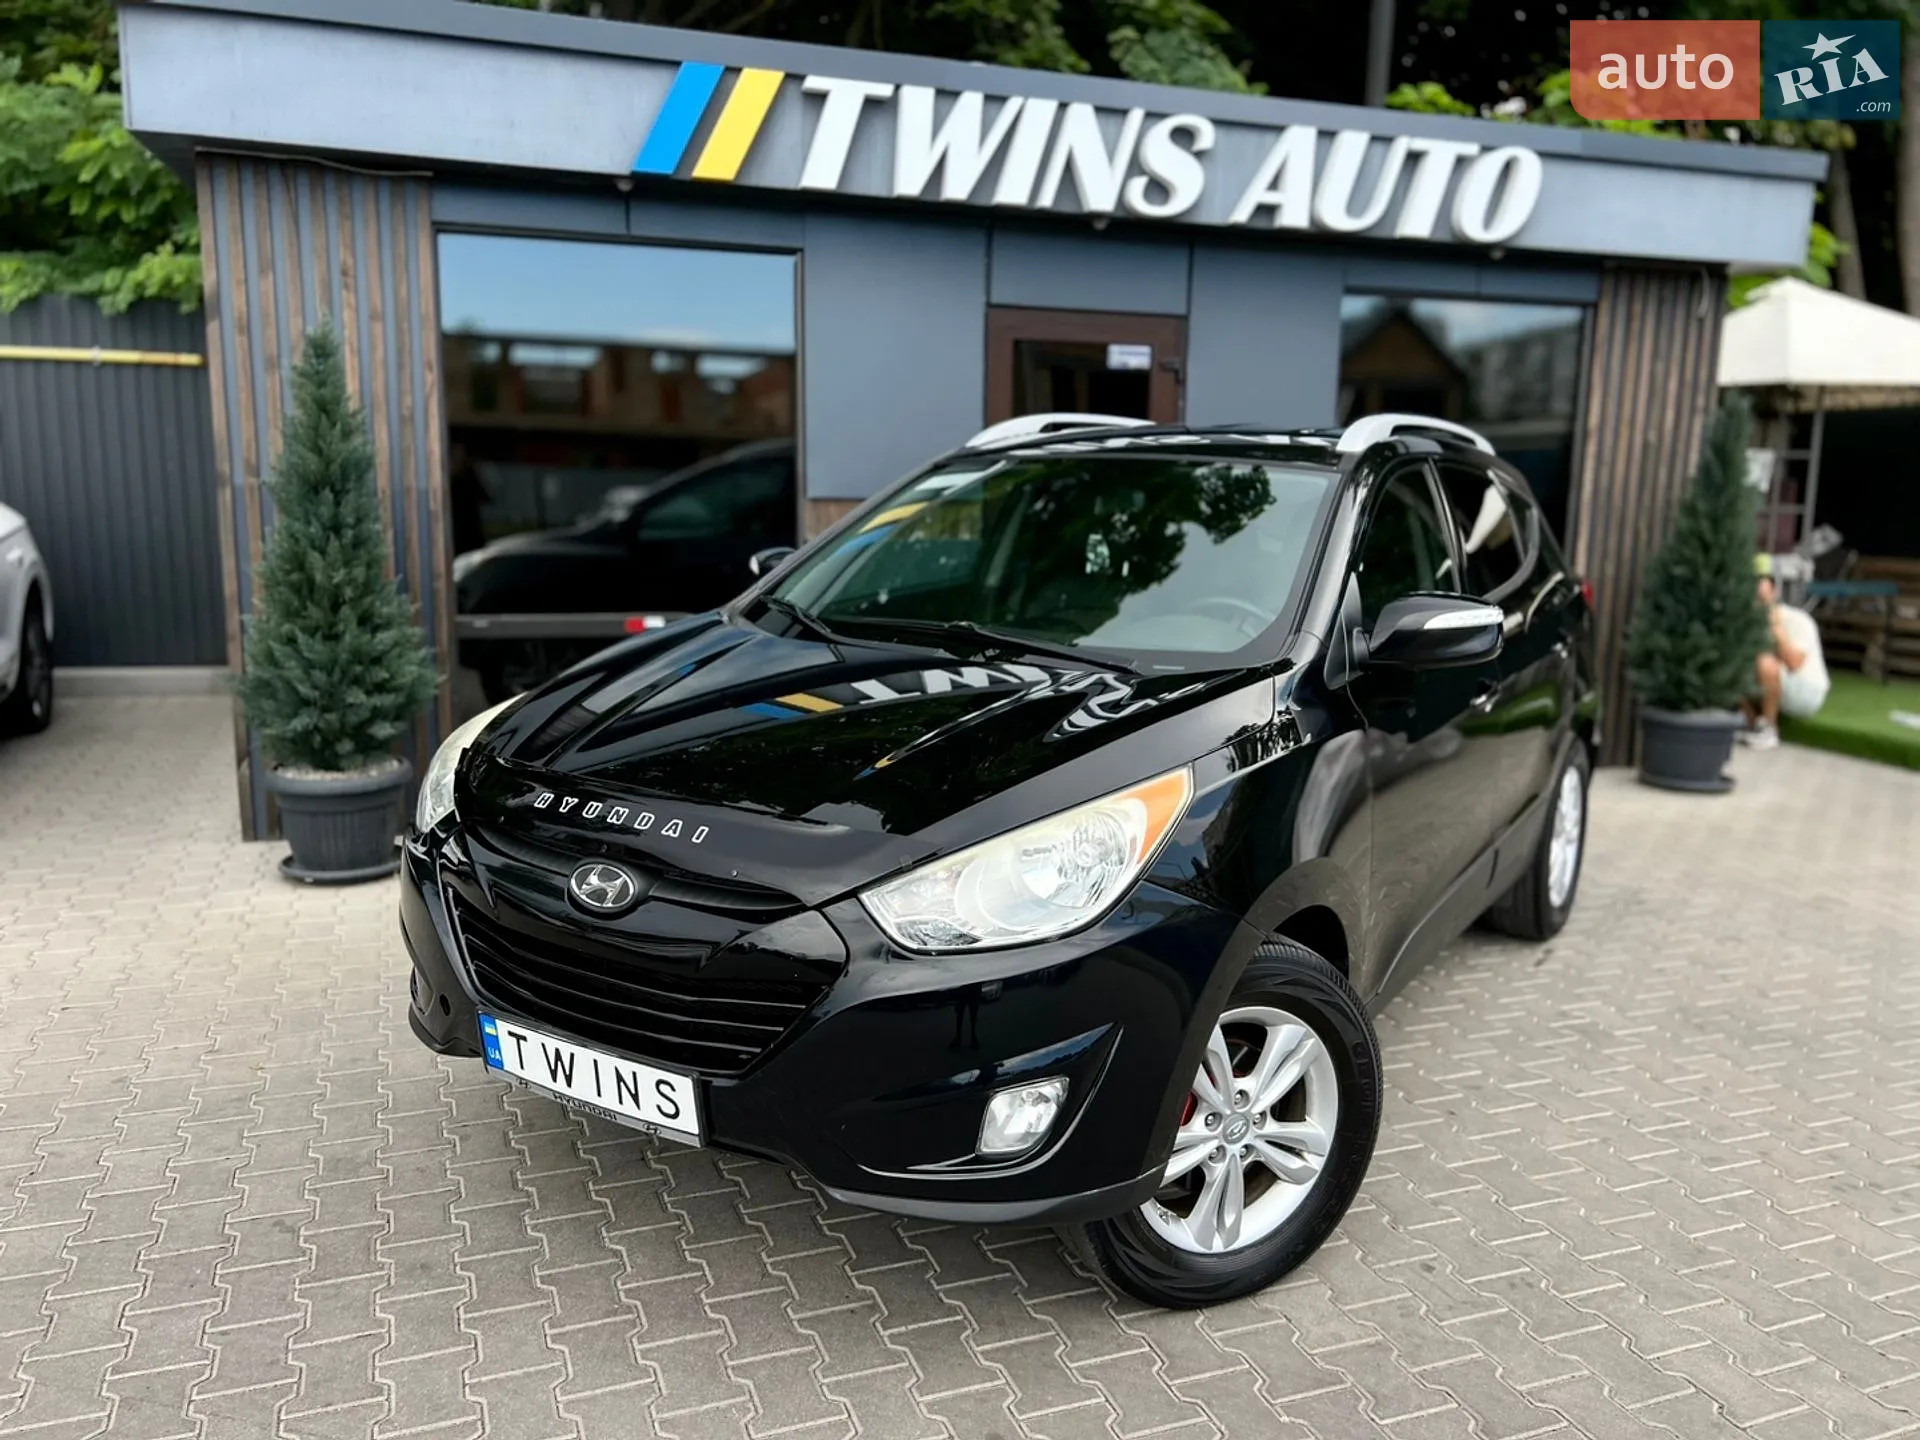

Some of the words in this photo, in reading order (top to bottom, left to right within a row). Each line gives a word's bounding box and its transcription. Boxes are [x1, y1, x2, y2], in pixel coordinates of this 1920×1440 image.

[798, 74, 1216, 219] TWINS
[1230, 126, 1543, 245] AUTO
[534, 792, 709, 844] HYUNDAI
[488, 1046, 502, 1061] UA
[507, 1030, 680, 1120] TWINS
